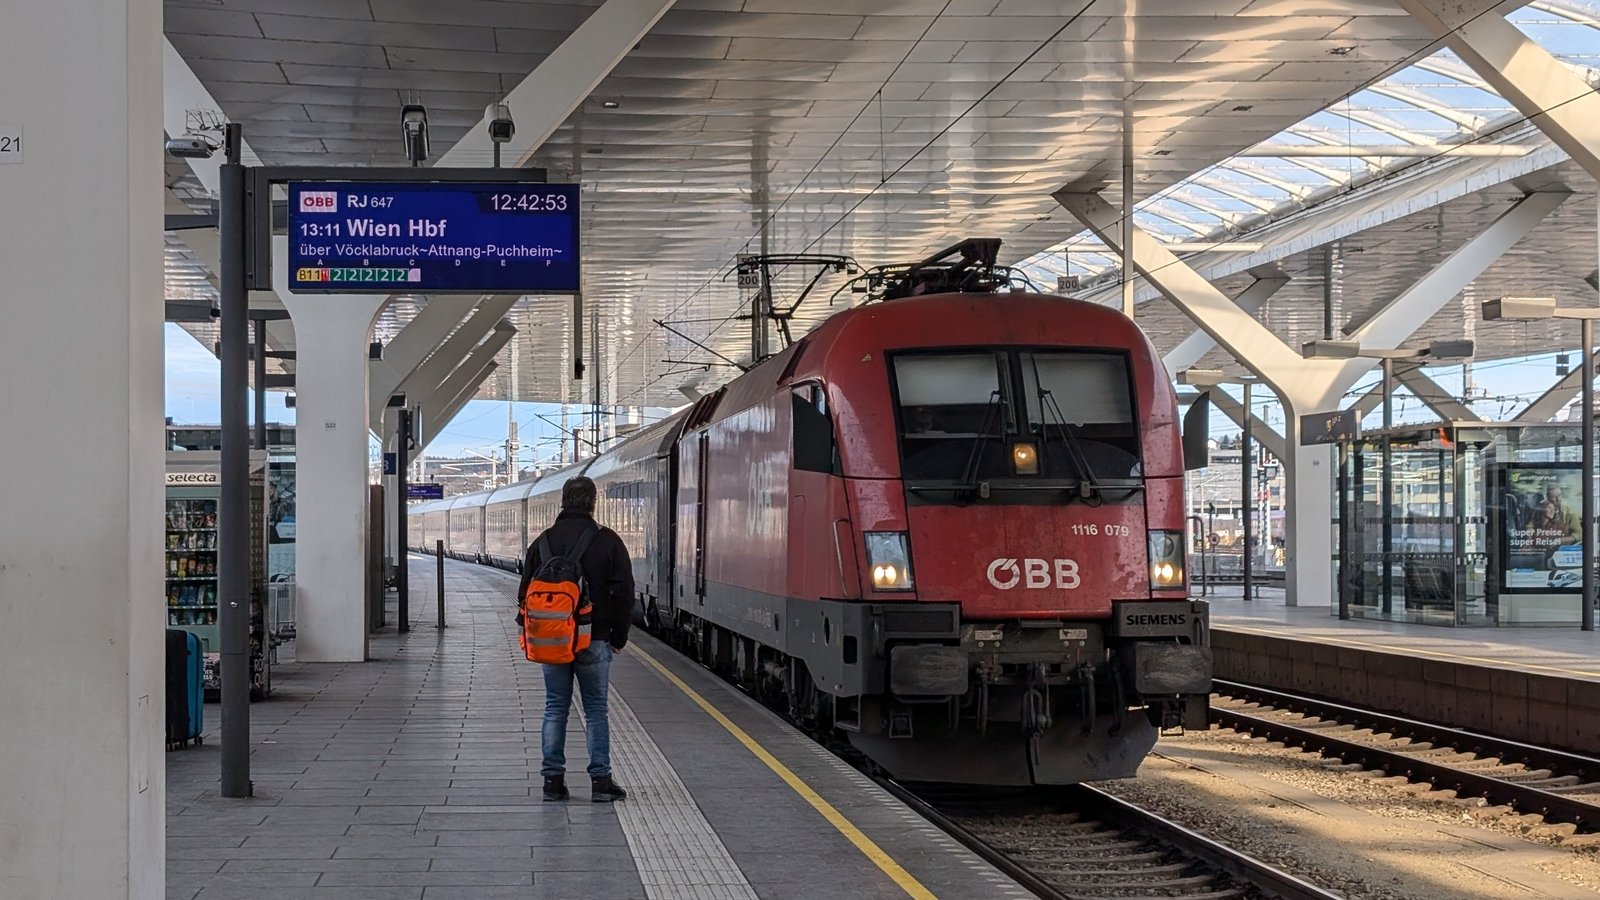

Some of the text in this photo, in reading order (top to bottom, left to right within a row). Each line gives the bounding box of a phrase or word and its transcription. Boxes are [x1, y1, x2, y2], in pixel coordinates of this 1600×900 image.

[303, 196, 334, 207] ÖBB
[347, 195, 394, 208] RJ 647
[491, 194, 567, 210] 12:42:53
[300, 219, 447, 237] 13:11 Wien Hbf
[300, 243, 331, 256] über
[739, 276, 758, 285] 200
[1060, 280, 1077, 290] 200
[167, 473, 217, 482] selecta
[1071, 524, 1130, 537] 1116 079
[1510, 528, 1535, 538] Super
[1510, 539, 1534, 548] super
[986, 558, 1081, 590] ÖBB
[1126, 614, 1186, 626] SIEMENS
